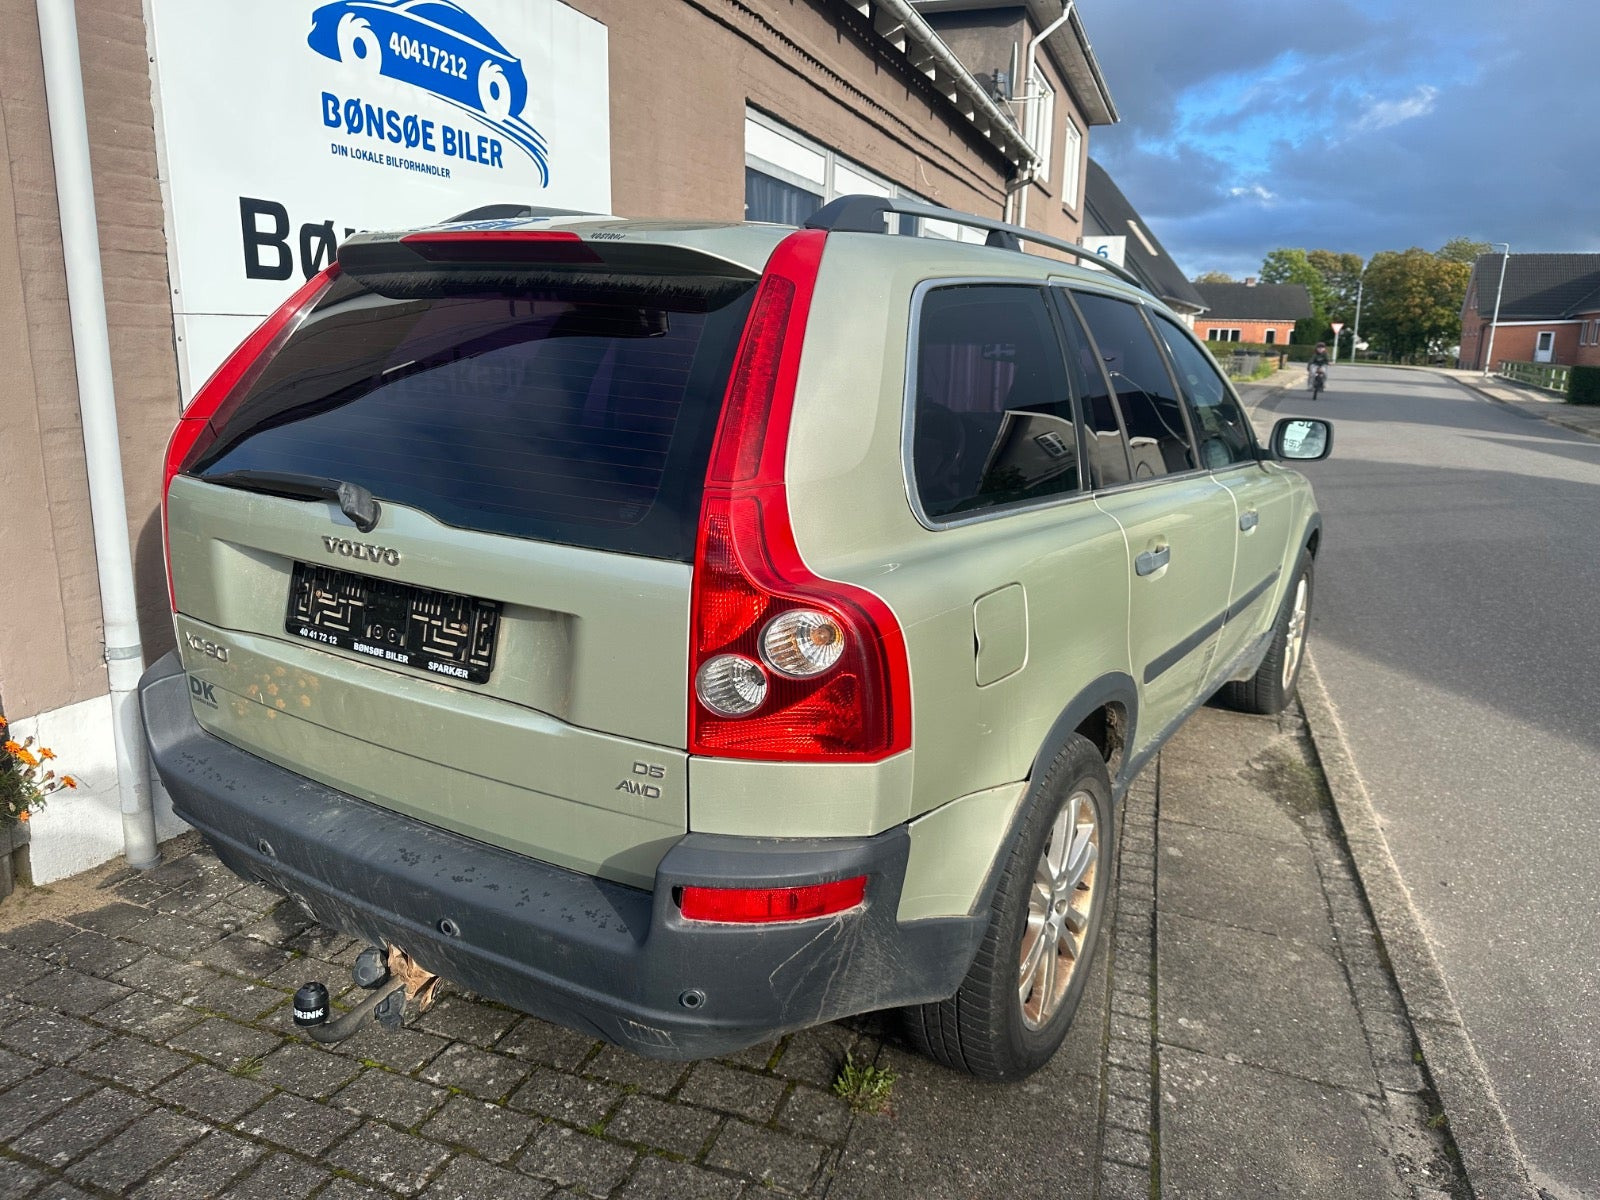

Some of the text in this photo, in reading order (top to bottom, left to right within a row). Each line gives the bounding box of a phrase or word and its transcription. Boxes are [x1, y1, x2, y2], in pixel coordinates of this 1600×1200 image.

[389, 31, 468, 81] 40417212
[321, 91, 504, 169] BØNSØE BILER
[331, 143, 451, 179] DIN LOKALE BILFORHANDLER
[320, 536, 401, 567] VOLVO
[185, 631, 230, 663] XC90
[299, 628, 338, 646] 40 41 72 12
[353, 642, 409, 665] BØNSØE BILER
[427, 661, 469, 679] SPARKÆR
[189, 675, 217, 704] DK
[632, 761, 665, 778] D5
[615, 779, 661, 799] AWD
